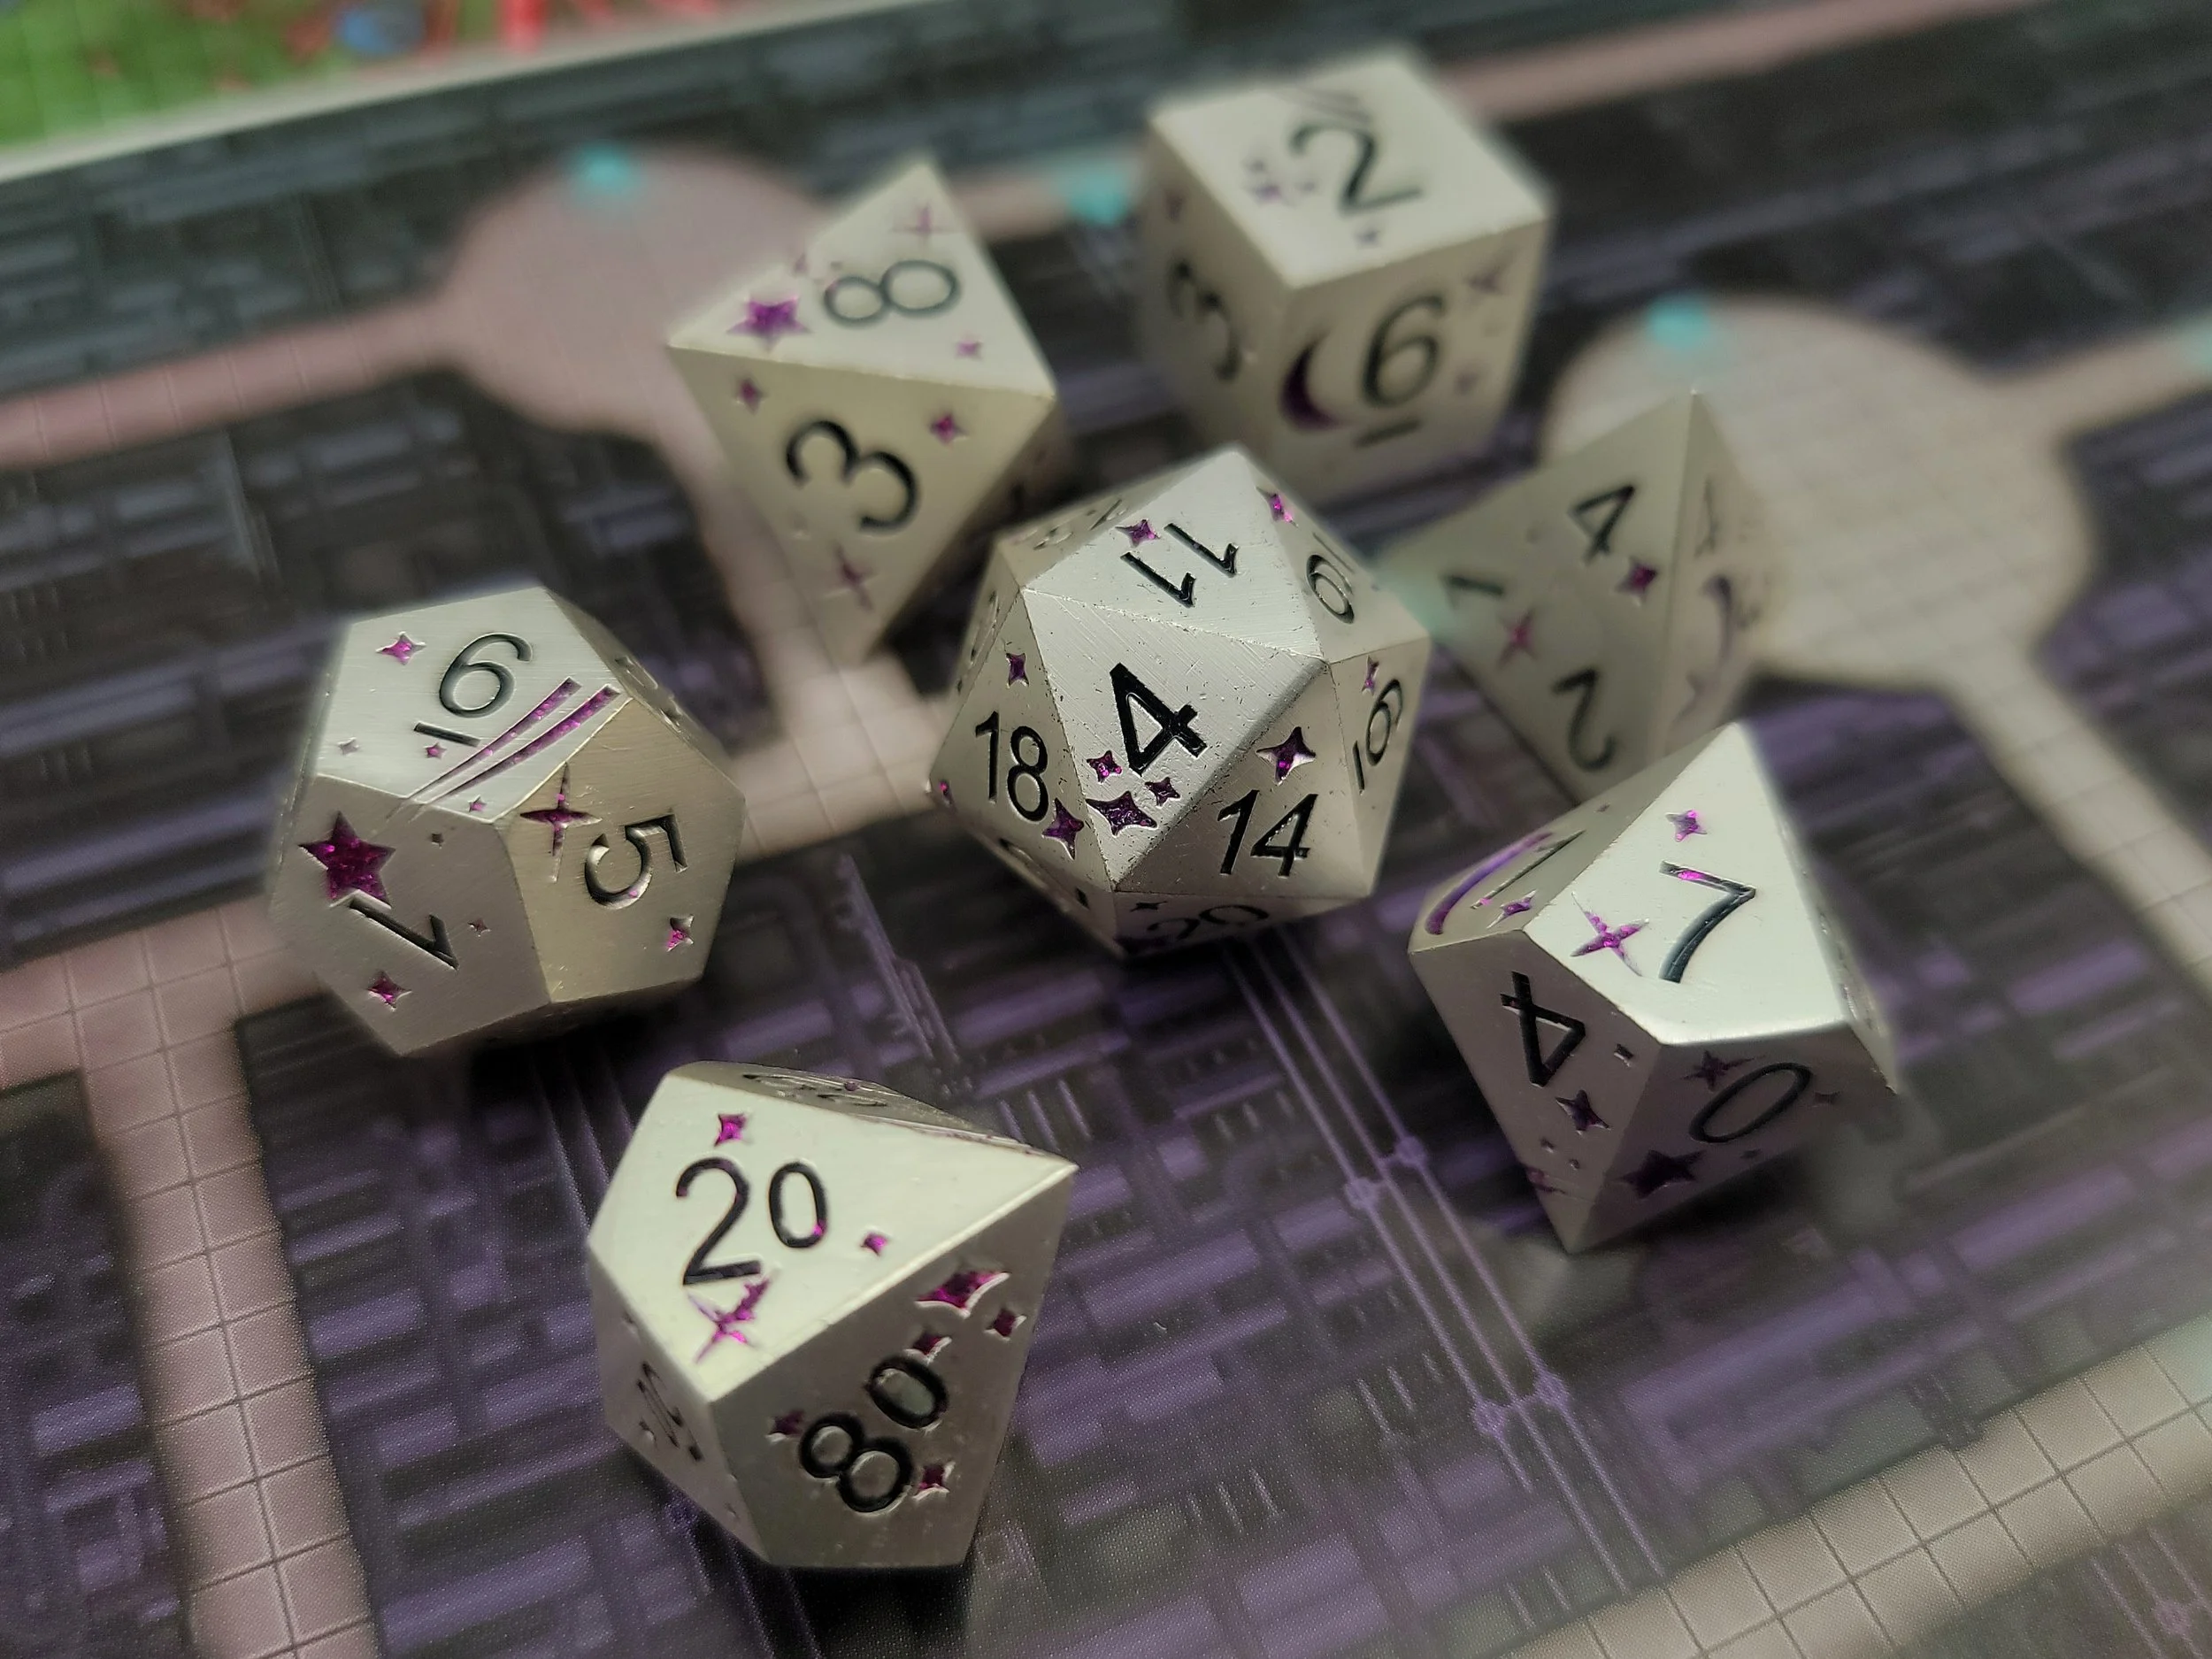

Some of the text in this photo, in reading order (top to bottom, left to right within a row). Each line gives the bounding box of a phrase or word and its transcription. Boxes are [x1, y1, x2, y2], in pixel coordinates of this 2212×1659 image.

[1287, 120, 1426, 218] 2
[823, 259, 961, 327] 8
[1358, 293, 1448, 448] 6
[786, 419, 918, 534] 3
[1568, 484, 1635, 568] 4
[1119, 522, 1240, 609] 11
[413, 631, 534, 749] 6
[1110, 663, 1209, 777] 4
[1352, 678, 1404, 791] 6
[975, 710, 1049, 823] 18
[585, 809, 688, 910] 5
[1217, 788, 1319, 878] 14
[349, 895, 460, 972] 1
[1658, 859, 1757, 984] 7
[1501, 971, 1586, 1087] 4
[1688, 1061, 1814, 1144] 0
[674, 1156, 830, 1286] 20
[799, 1354, 950, 1515] 80
